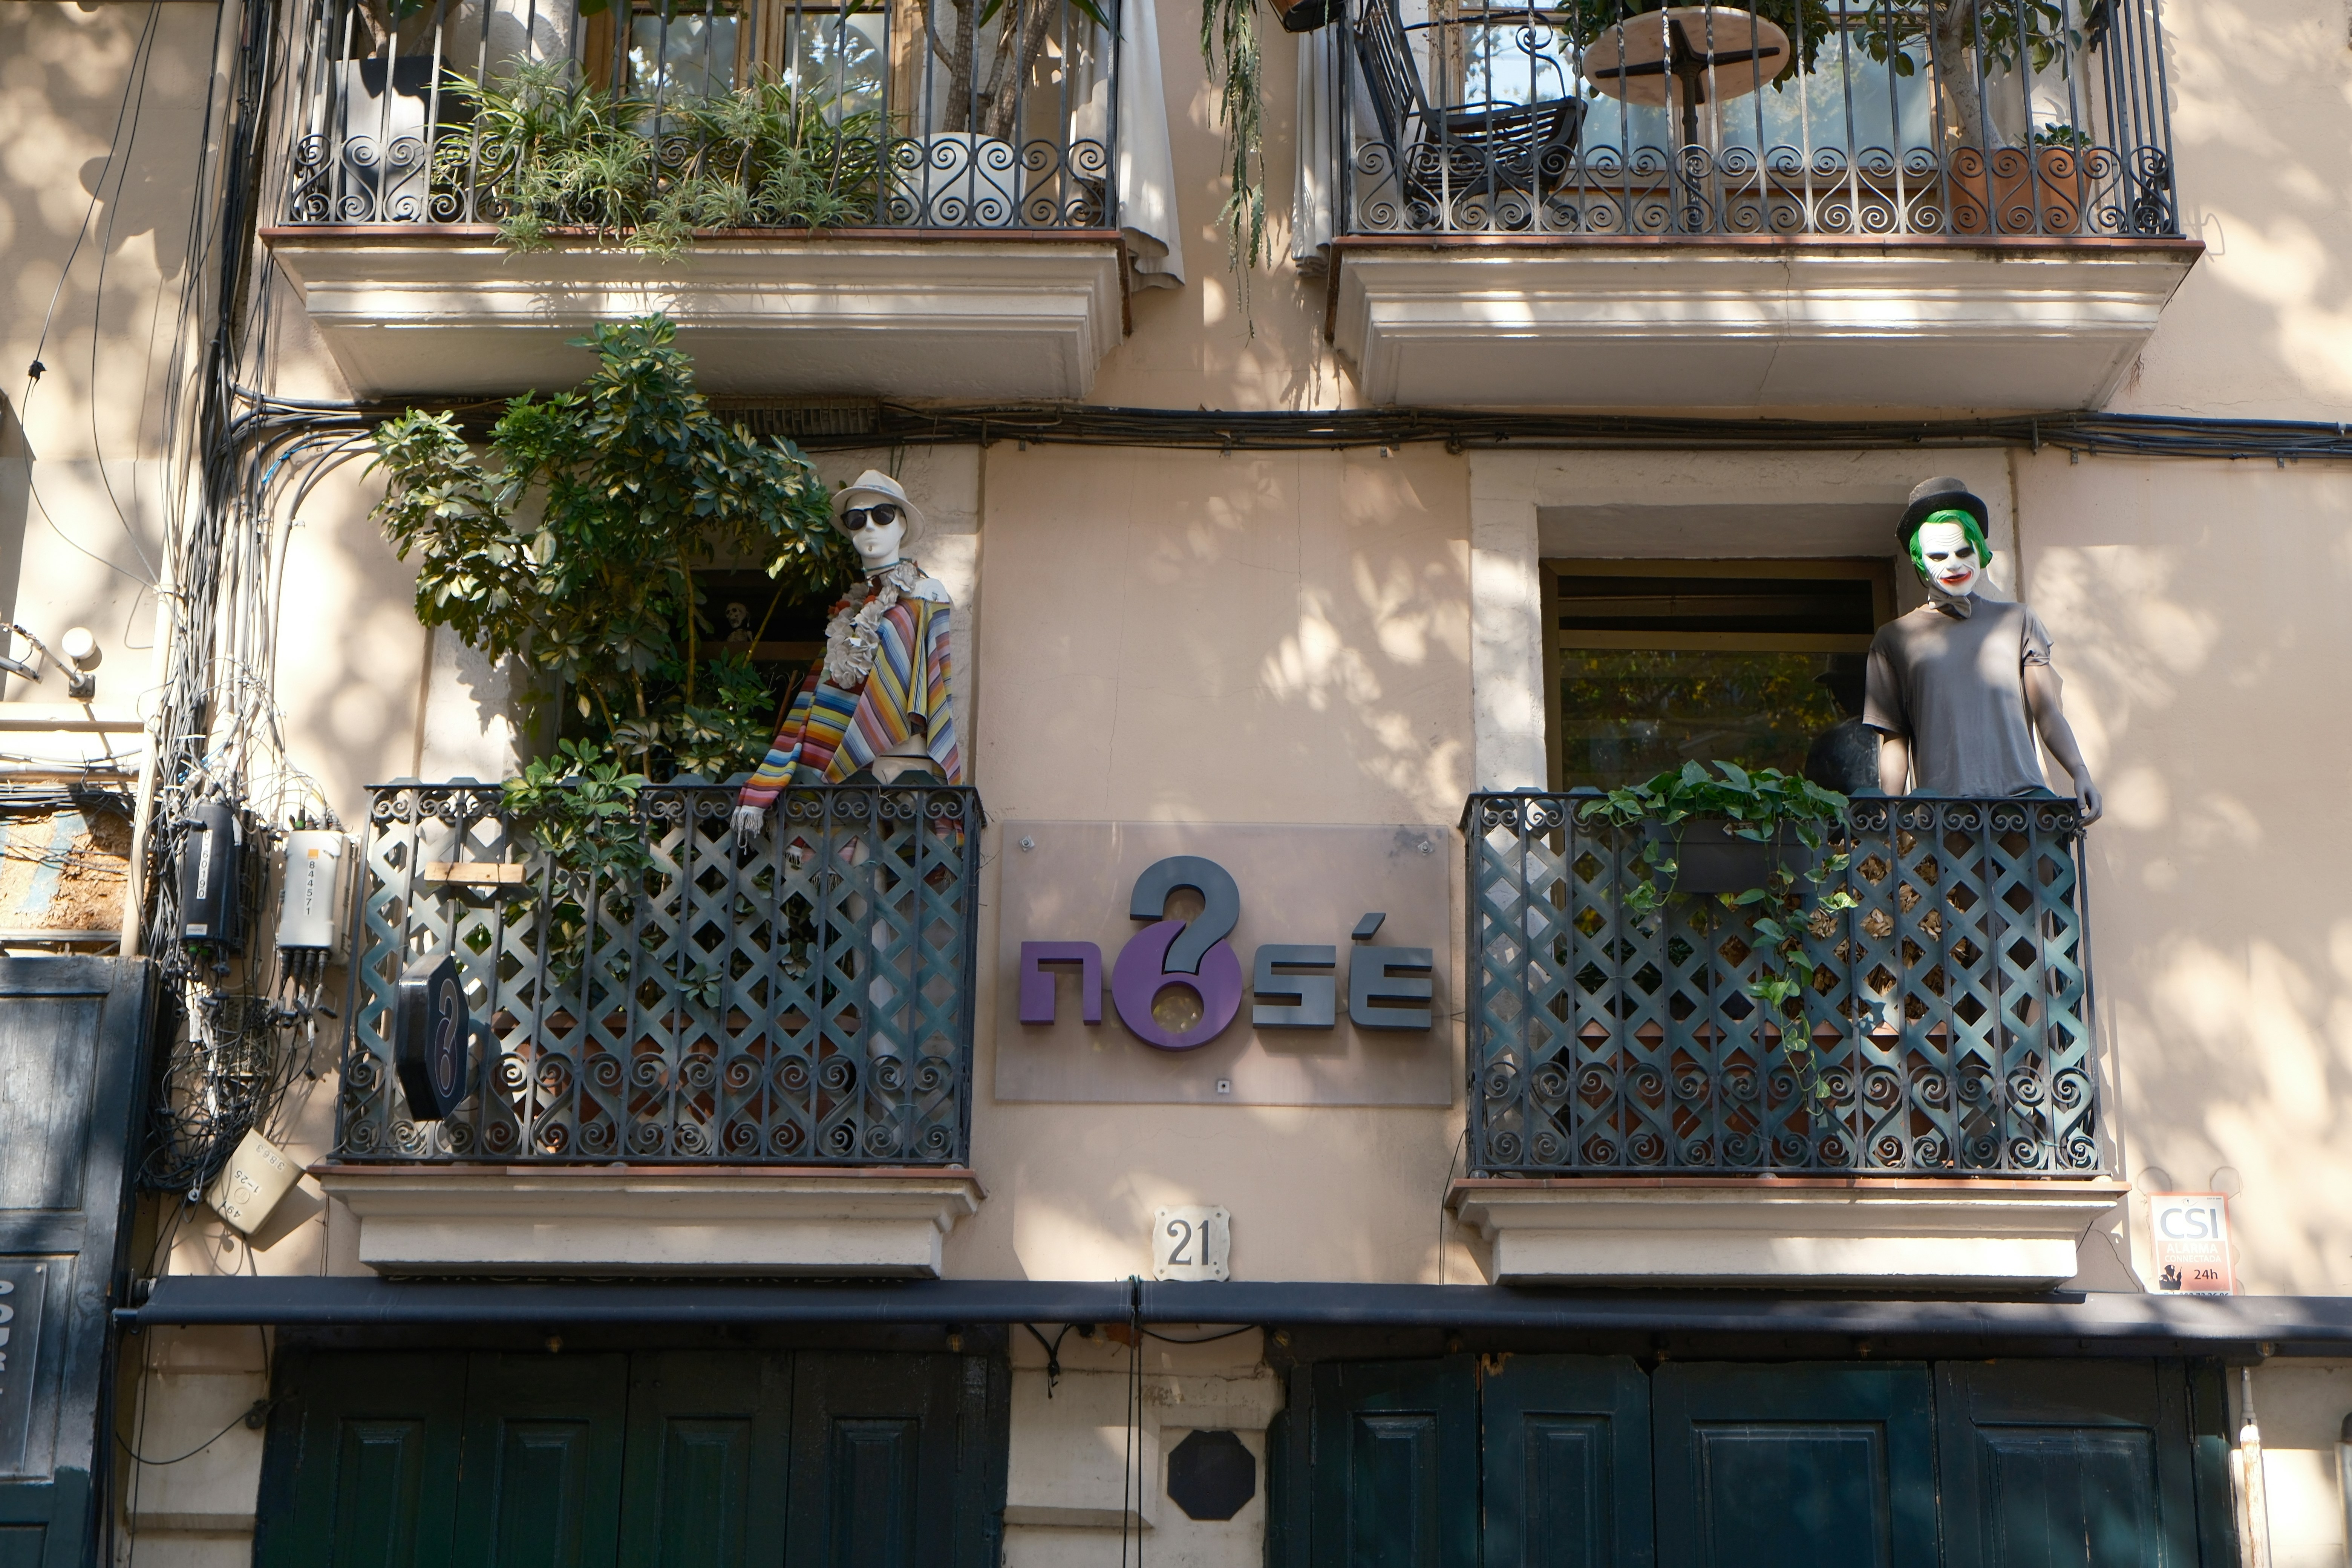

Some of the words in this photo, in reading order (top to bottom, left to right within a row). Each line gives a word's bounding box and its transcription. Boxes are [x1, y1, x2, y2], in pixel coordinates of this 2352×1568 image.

[305, 861, 315, 916] 844571
[256, 1144, 285, 1170] 3863
[234, 1170, 260, 1193] 1-25
[2160, 1208, 2219, 1239] CSI
[1167, 1219, 1209, 1266] 21
[2167, 1243, 2218, 1254] ALARMA
[2164, 1254, 2222, 1263] CONNECTADA
[2194, 1268, 2218, 1280] 24h
